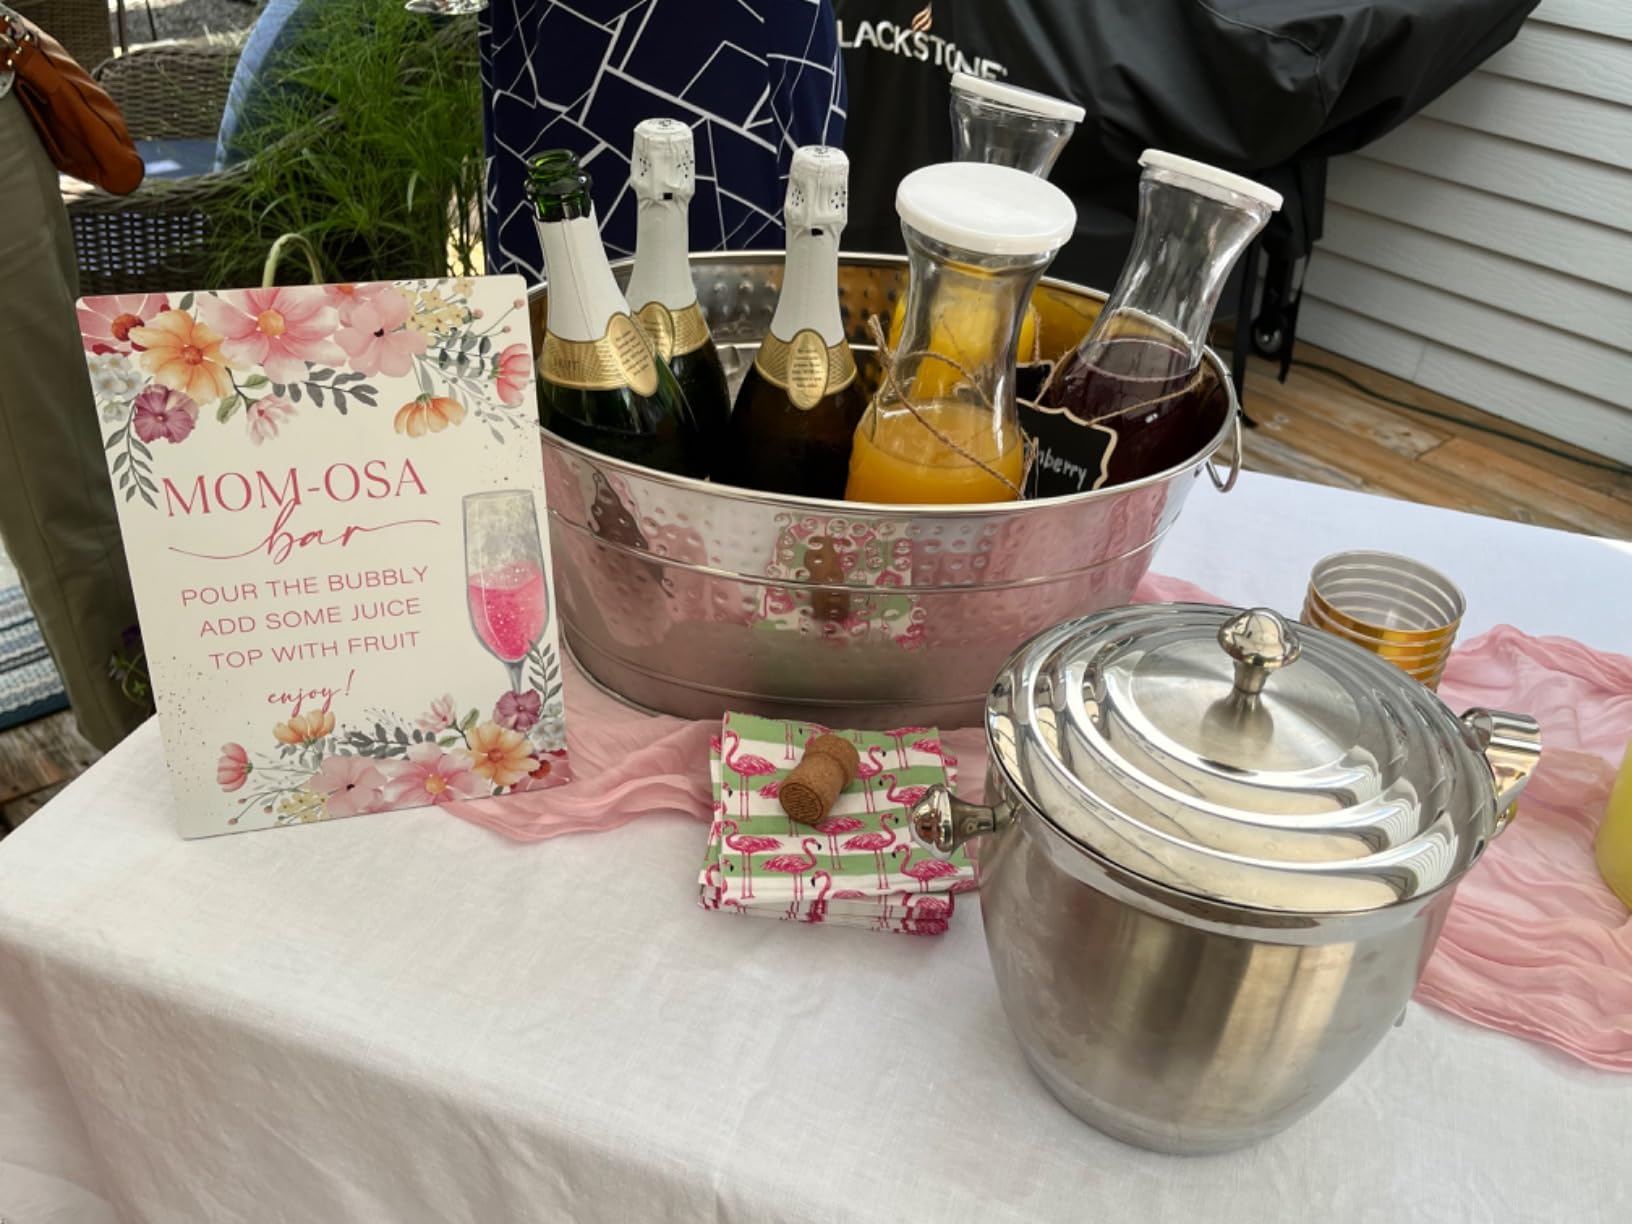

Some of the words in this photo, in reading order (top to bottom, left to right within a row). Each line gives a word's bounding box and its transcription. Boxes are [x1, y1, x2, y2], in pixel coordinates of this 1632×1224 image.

[836, 20, 1003, 81] LACKSTONE
[162, 458, 427, 517] MOM-OSA
[1031, 446, 1088, 491] nberry
[168, 498, 440, 565] bar
[181, 583, 258, 608] POUR
[266, 576, 319, 600] THE
[328, 565, 429, 593] BUBBLY
[200, 616, 256, 638] ADD
[265, 606, 343, 631] SOME
[351, 597, 423, 622] JUICE
[208, 650, 263, 670] TOP
[271, 640, 339, 664] WITH
[347, 631, 421, 655] FRUIT
[267, 668, 355, 718] enjoy!
